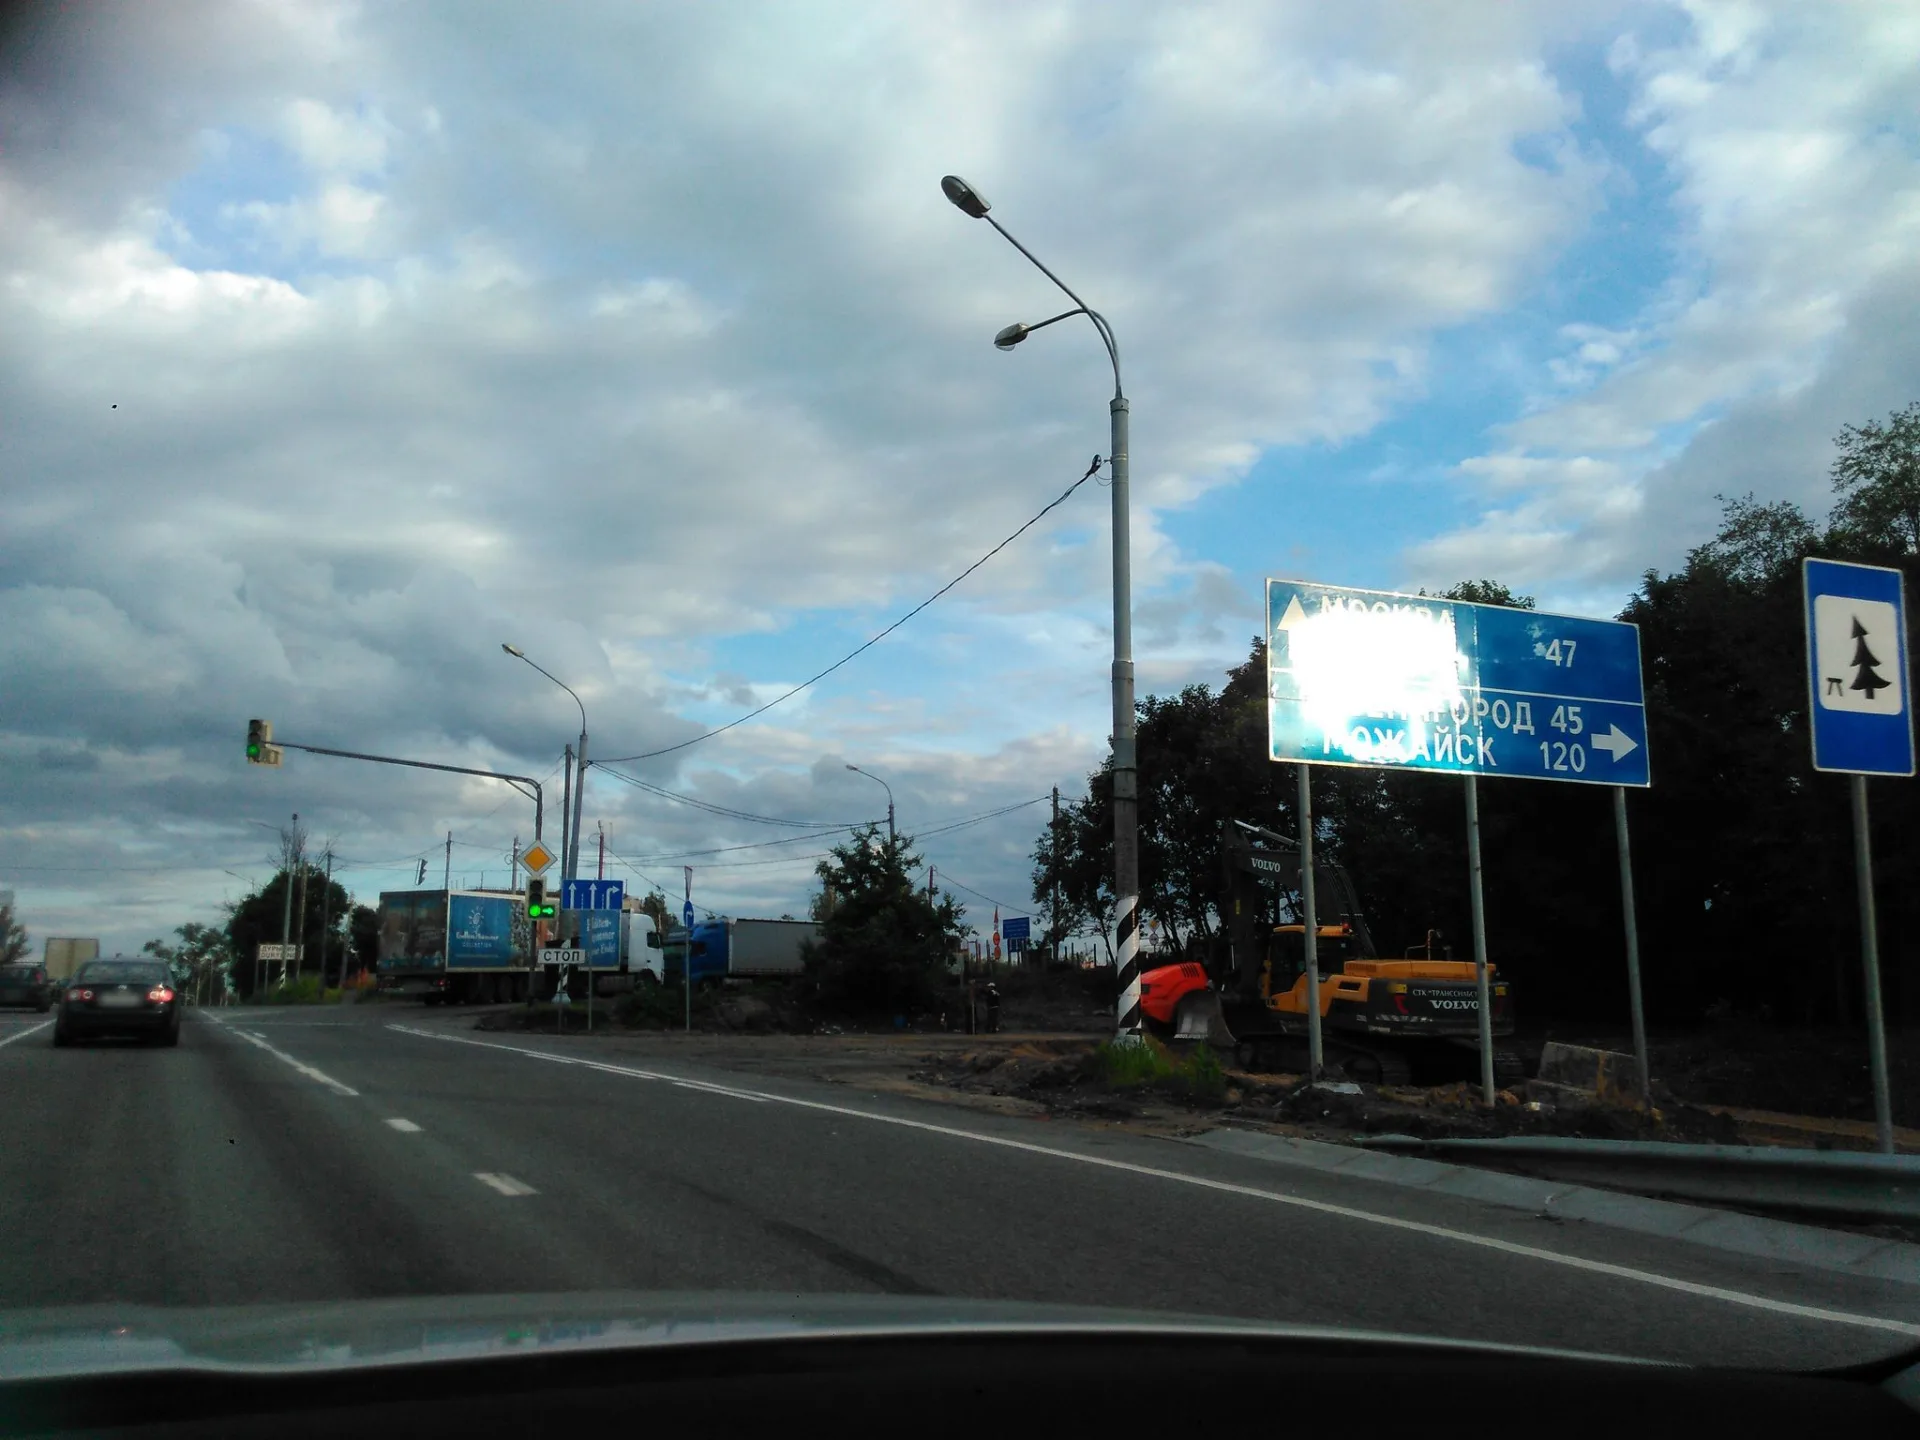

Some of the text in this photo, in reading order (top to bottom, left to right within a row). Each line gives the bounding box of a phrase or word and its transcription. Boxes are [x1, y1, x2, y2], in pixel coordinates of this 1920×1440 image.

[1545, 638, 1577, 668] 47
[1550, 705, 1584, 735] 45
[1540, 741, 1586, 773] 120
[1250, 857, 1281, 873] VOLVO
[544, 951, 580, 962] СТОП
[1429, 999, 1480, 1010] VOLVO
